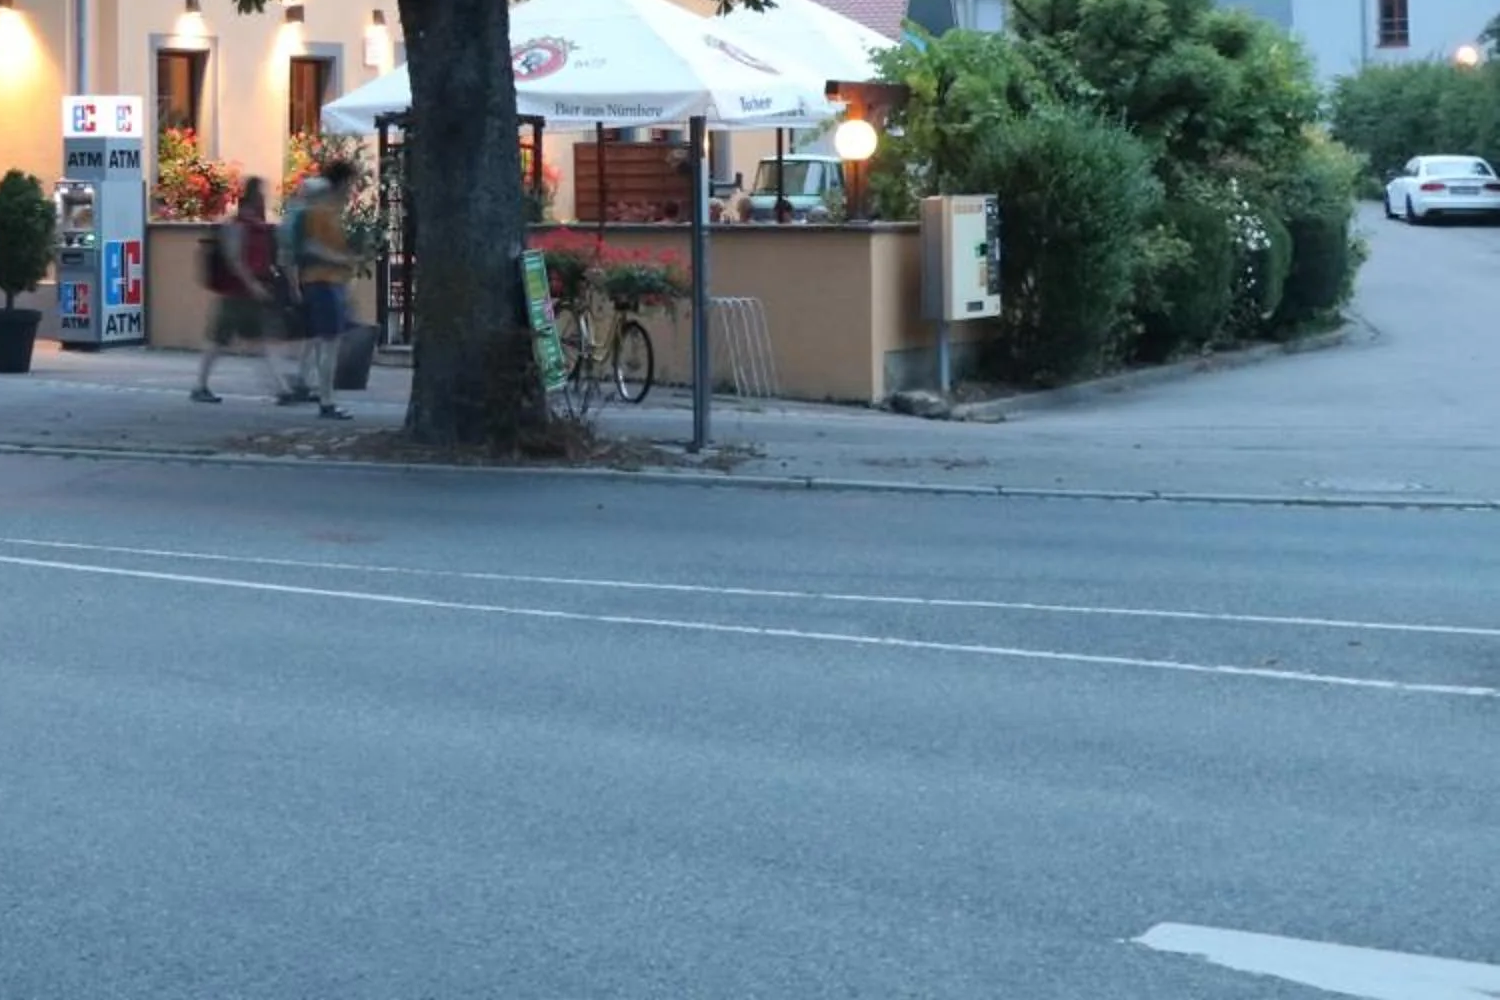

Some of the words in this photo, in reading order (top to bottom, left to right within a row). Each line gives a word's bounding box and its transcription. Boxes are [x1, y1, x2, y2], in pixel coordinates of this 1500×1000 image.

[67, 151, 103, 168] ATM
[108, 150, 140, 168] ATM
[61, 317, 90, 329] ATM
[105, 311, 141, 334] ATM
